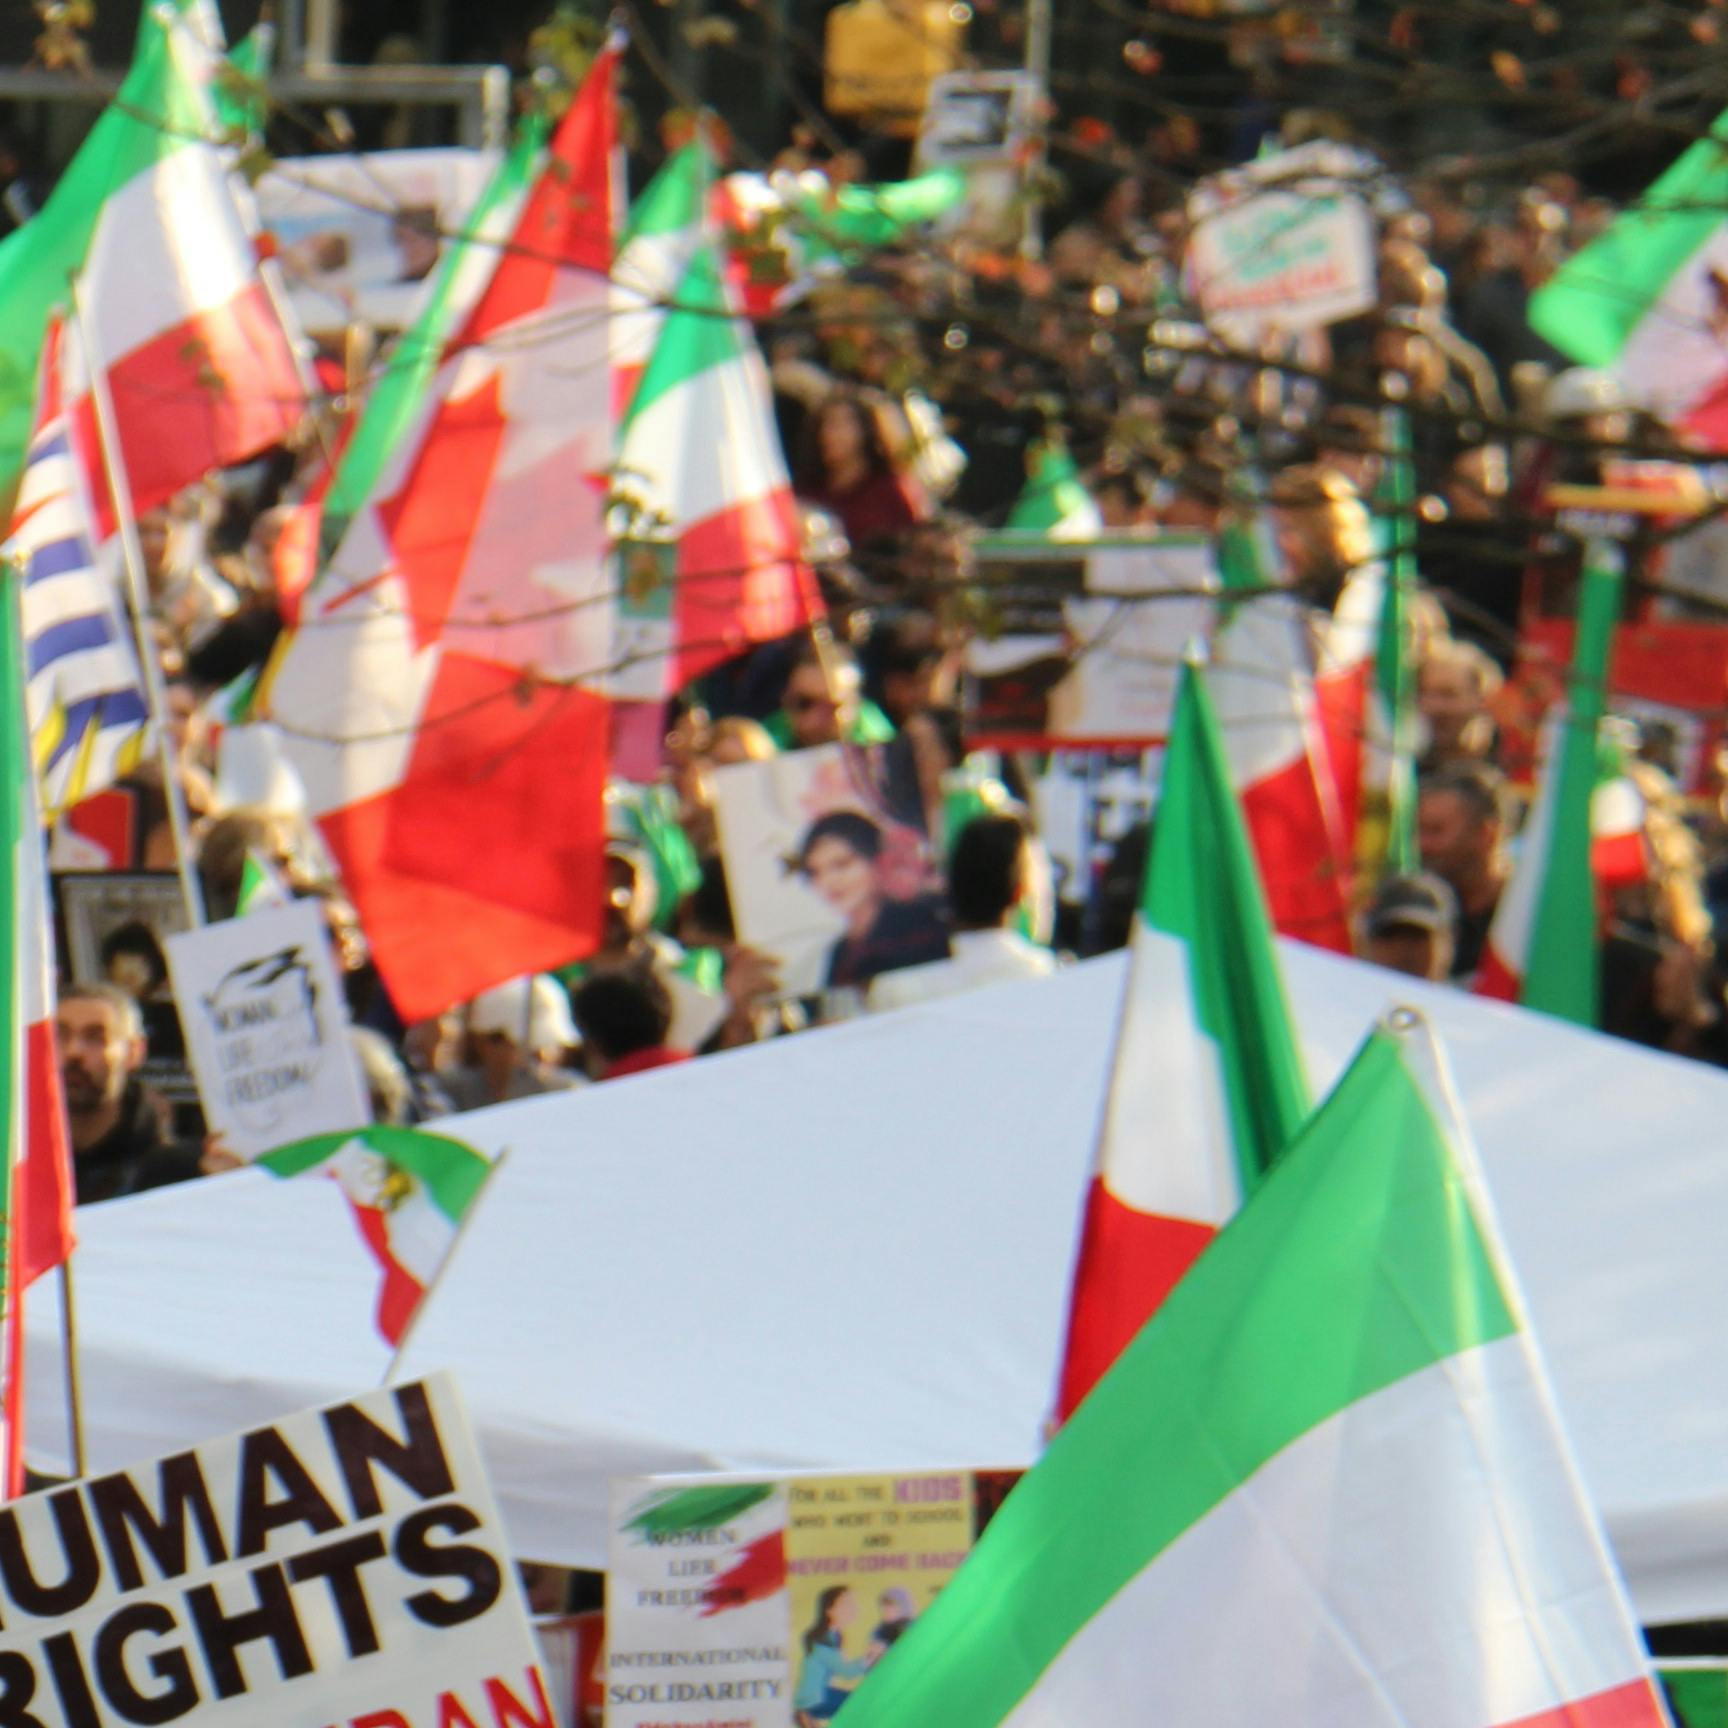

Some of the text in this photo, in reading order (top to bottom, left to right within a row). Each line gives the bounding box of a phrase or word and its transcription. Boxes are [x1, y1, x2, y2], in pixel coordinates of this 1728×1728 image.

[668, 1558, 716, 1577] LIFE
[610, 1647, 785, 1668] INTERNATIONAL
[609, 1680, 784, 1705] SOLIDARITY
